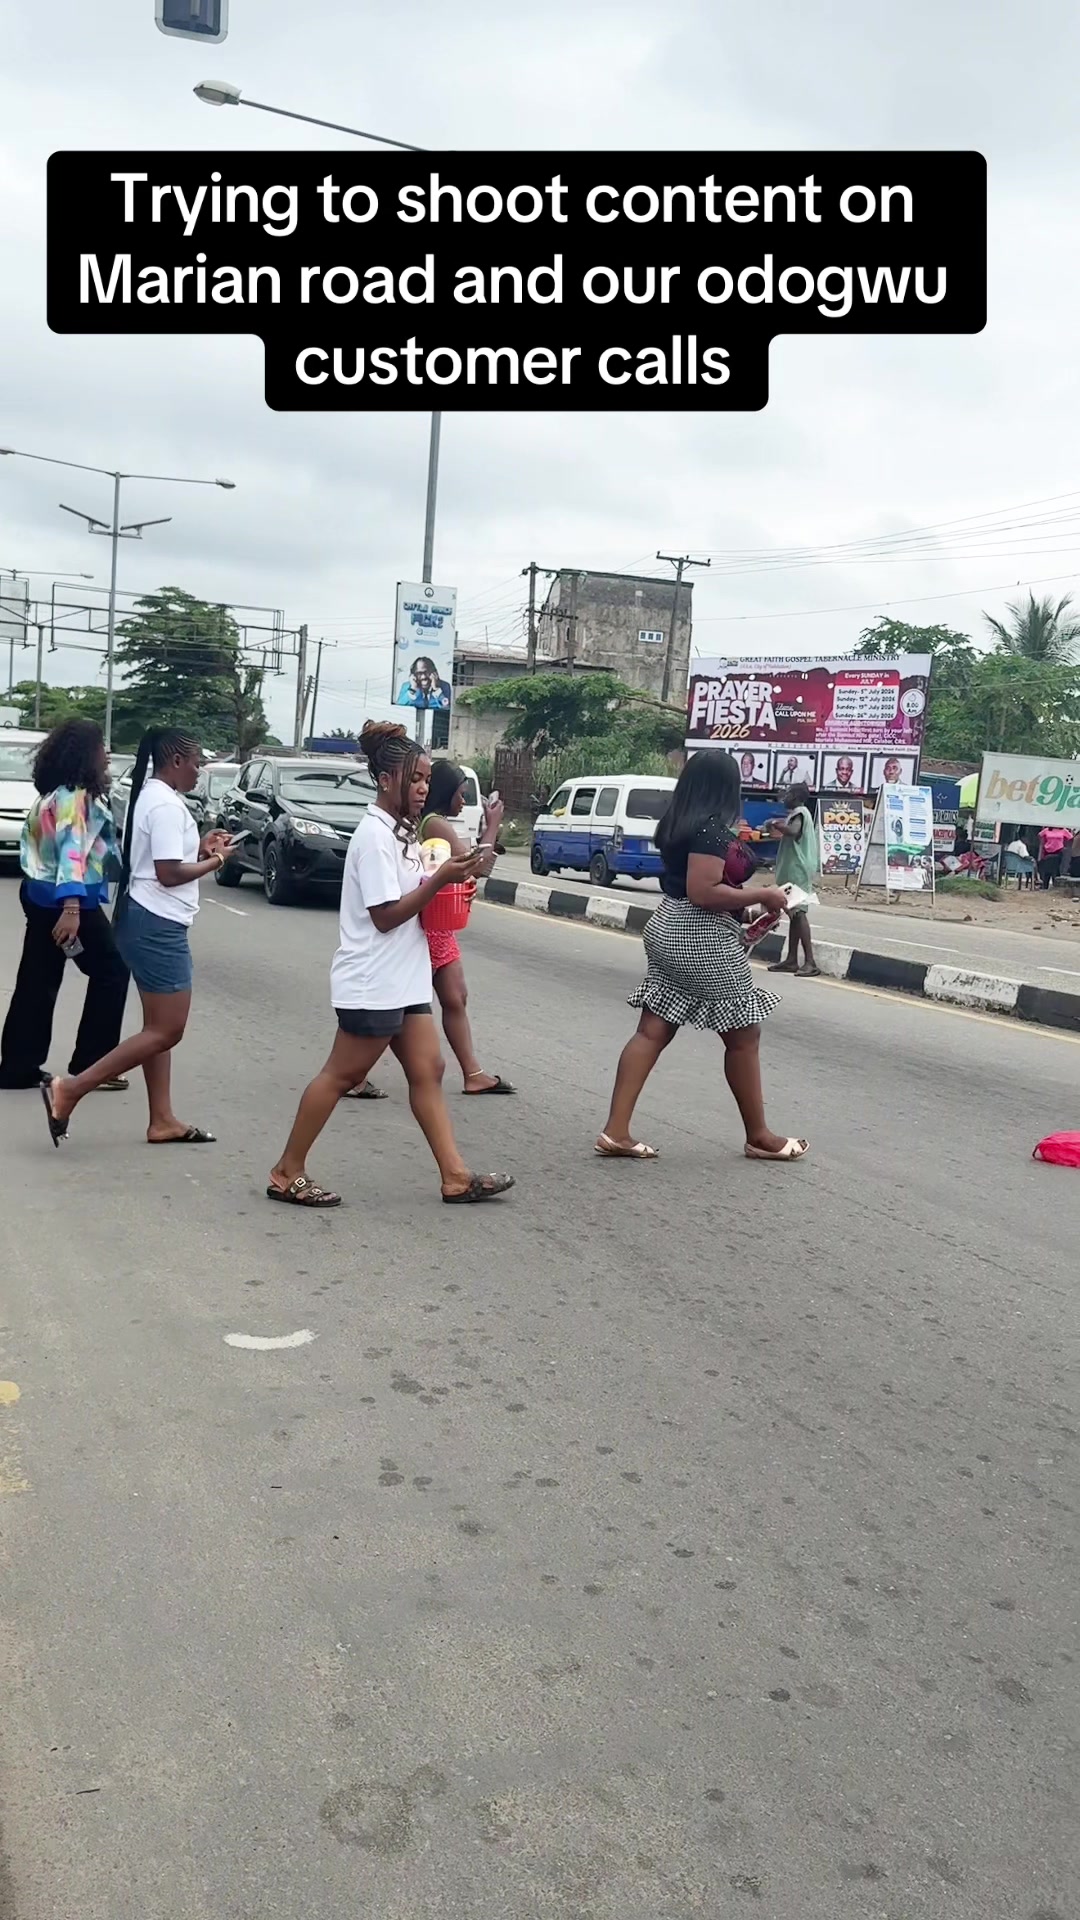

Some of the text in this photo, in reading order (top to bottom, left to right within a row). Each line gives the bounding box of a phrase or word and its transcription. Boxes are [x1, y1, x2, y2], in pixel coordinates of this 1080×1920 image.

[785, 655, 811, 663] GOSPEL
[815, 654, 862, 662] TABERNACLE
[863, 654, 900, 662] MINISTRY
[694, 680, 773, 702] PRAYER
[689, 699, 778, 732] FIESTA
[710, 724, 751, 739] 2026
[823, 811, 861, 824] POS
[823, 823, 862, 832] SERVICES
